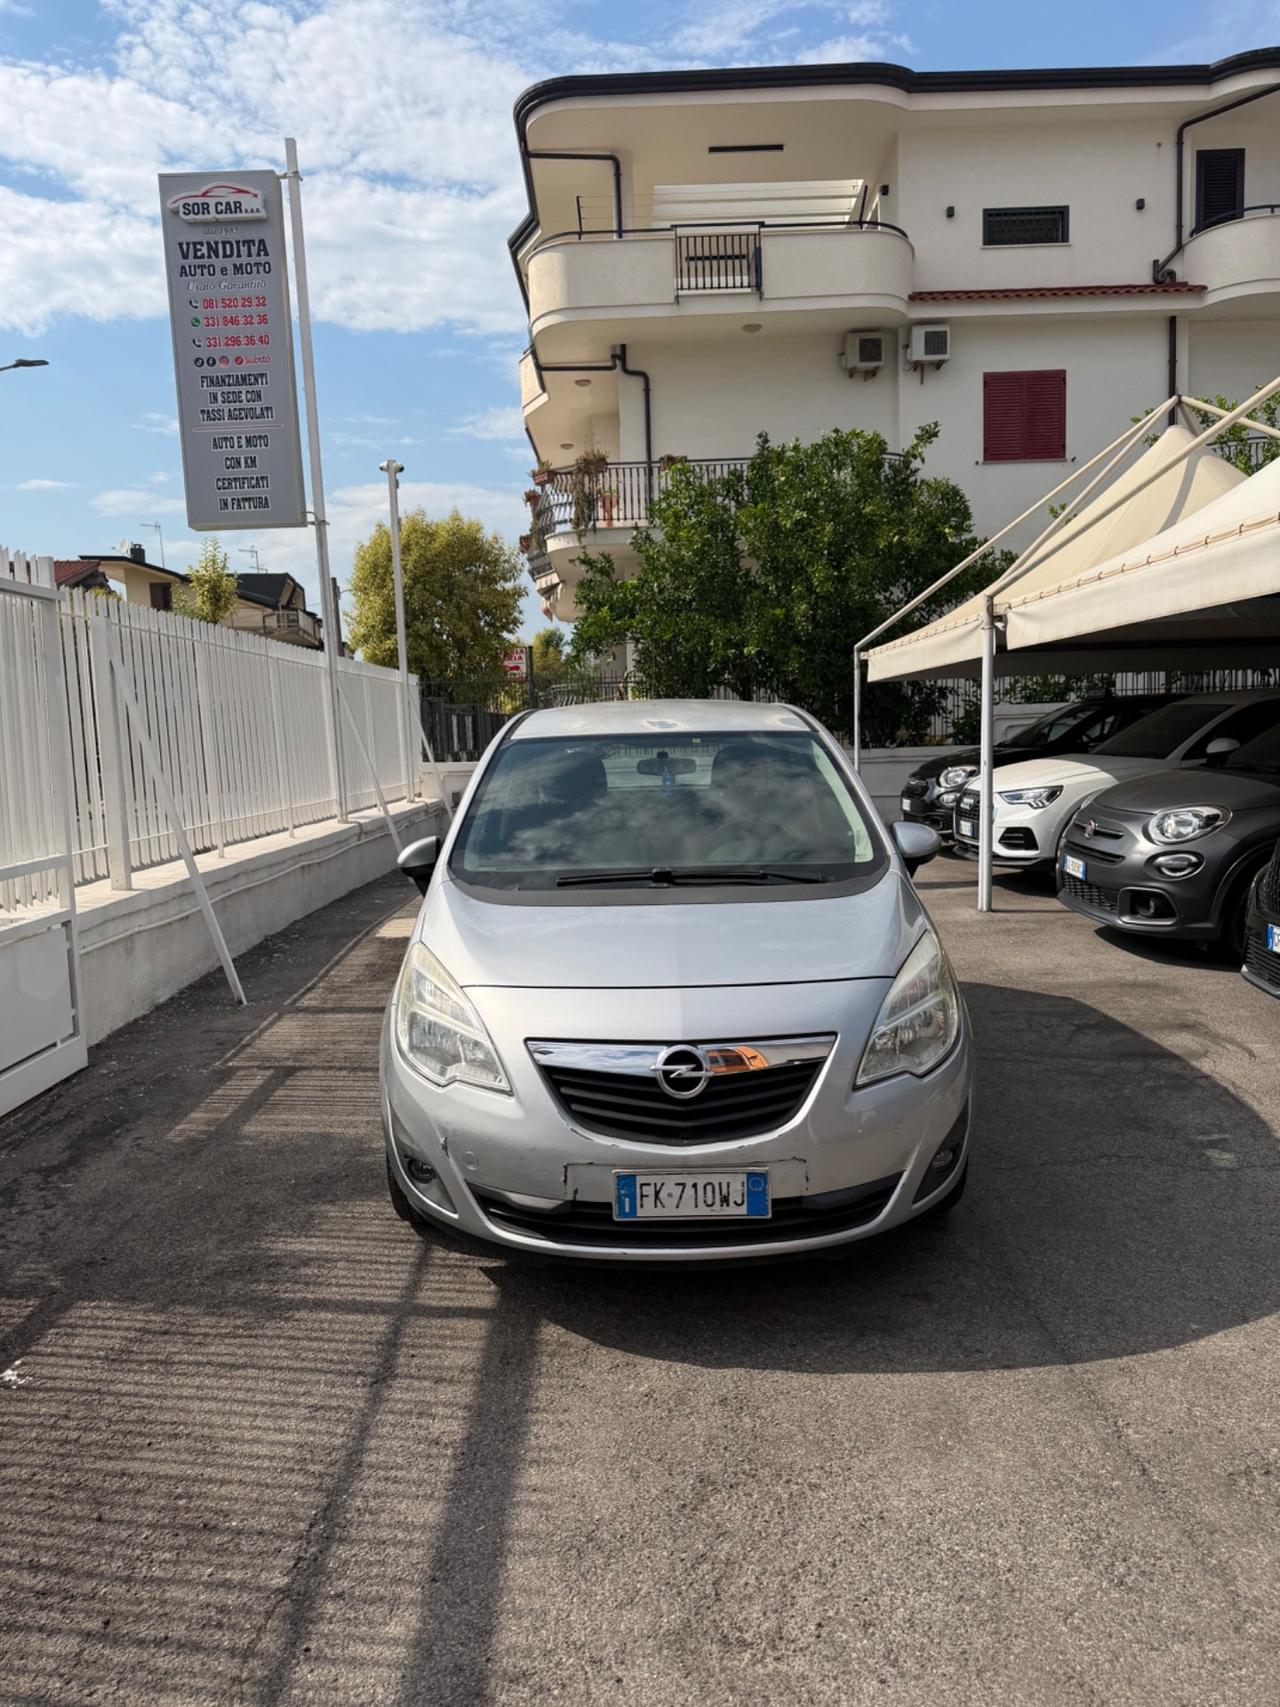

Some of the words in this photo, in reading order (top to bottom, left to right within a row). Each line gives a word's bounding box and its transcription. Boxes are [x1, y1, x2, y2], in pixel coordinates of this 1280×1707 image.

[182, 202, 211, 216] SOR
[215, 201, 243, 215] CAR
[178, 238, 270, 260] VENDITA
[179, 264, 216, 277] AUTO
[220, 266, 229, 276] e
[233, 261, 272, 275] MOTO
[200, 373, 269, 388] FINANZIAMENTI
[209, 392, 218, 405] IN
[220, 391, 243, 404] SEDE
[245, 389, 263, 402] CON
[200, 408, 225, 422] TASSI
[227, 406, 274, 421] AGEVOLATI
[212, 435, 235, 450] AUTO
[237, 436, 243, 449] E
[245, 434, 269, 448] MOTO
[224, 456, 242, 470] CON
[244, 456, 258, 469] KM
[216, 476, 270, 491] CERTIFICATI
[219, 498, 229, 511] IN
[231, 496, 270, 510] FATTURA
